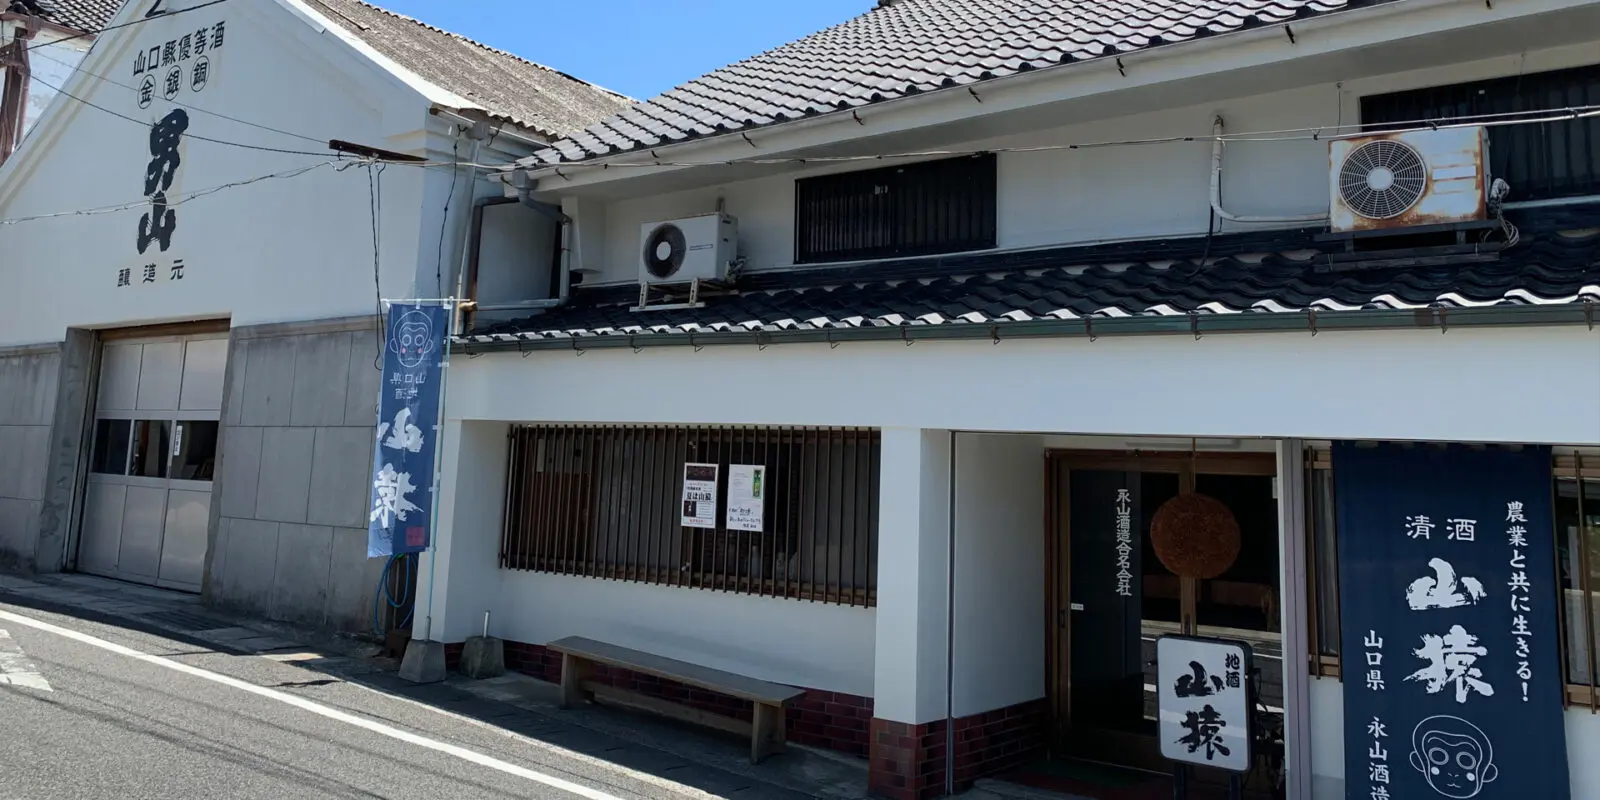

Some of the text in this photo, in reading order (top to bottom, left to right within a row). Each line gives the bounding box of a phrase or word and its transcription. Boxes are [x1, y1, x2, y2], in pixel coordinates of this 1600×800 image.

[137, 107, 189, 254] 男山
[1115, 488, 1133, 597] 永山酒造合名会社
[1404, 514, 1477, 542] 清酒
[1224, 653, 1241, 689] 地酒
[1364, 629, 1385, 691] 山口県
[1402, 557, 1495, 704] 山猿
[1173, 660, 1231, 761] 山猿
